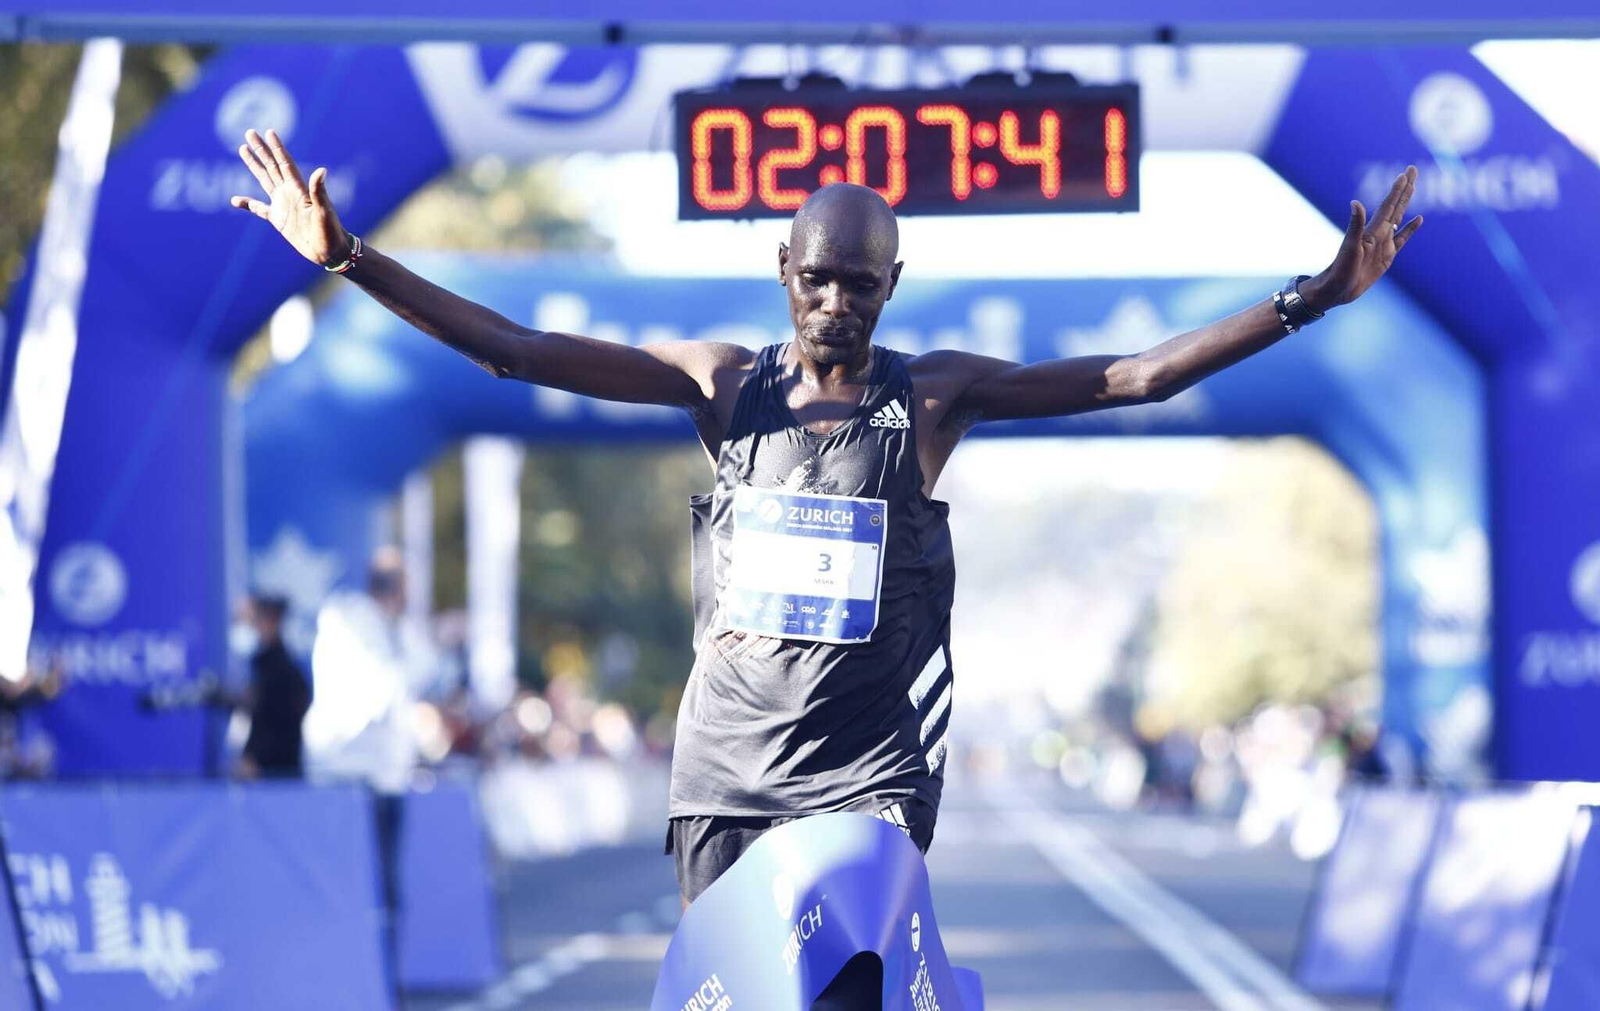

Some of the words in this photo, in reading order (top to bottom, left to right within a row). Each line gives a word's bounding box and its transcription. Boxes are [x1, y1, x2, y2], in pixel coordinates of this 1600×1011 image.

[692, 105, 1127, 211] 02:07:41
[869, 416, 911, 429] adidas
[787, 506, 855, 525] ZURICH
[817, 553, 832, 572] 3
[782, 904, 822, 976] ZURICH
